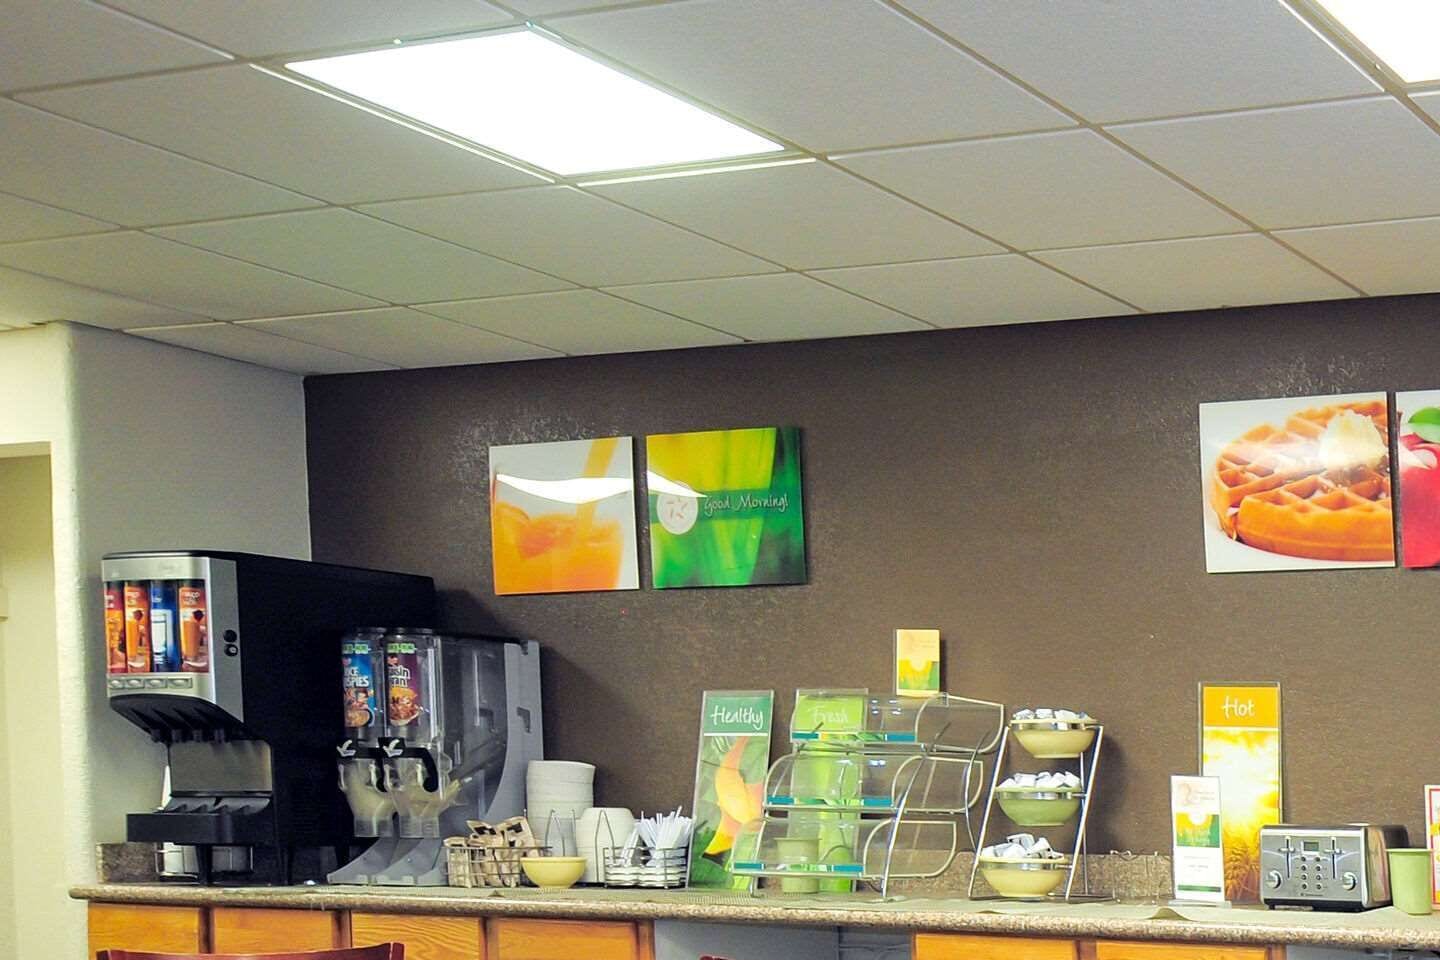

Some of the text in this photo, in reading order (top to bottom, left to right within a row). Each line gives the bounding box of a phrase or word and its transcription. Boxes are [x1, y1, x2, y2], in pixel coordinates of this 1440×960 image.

[704, 493, 788, 517] Good Morning!
[711, 705, 763, 730] Healthy
[813, 705, 848, 723] Fresh
[1221, 695, 1255, 719] Hot
